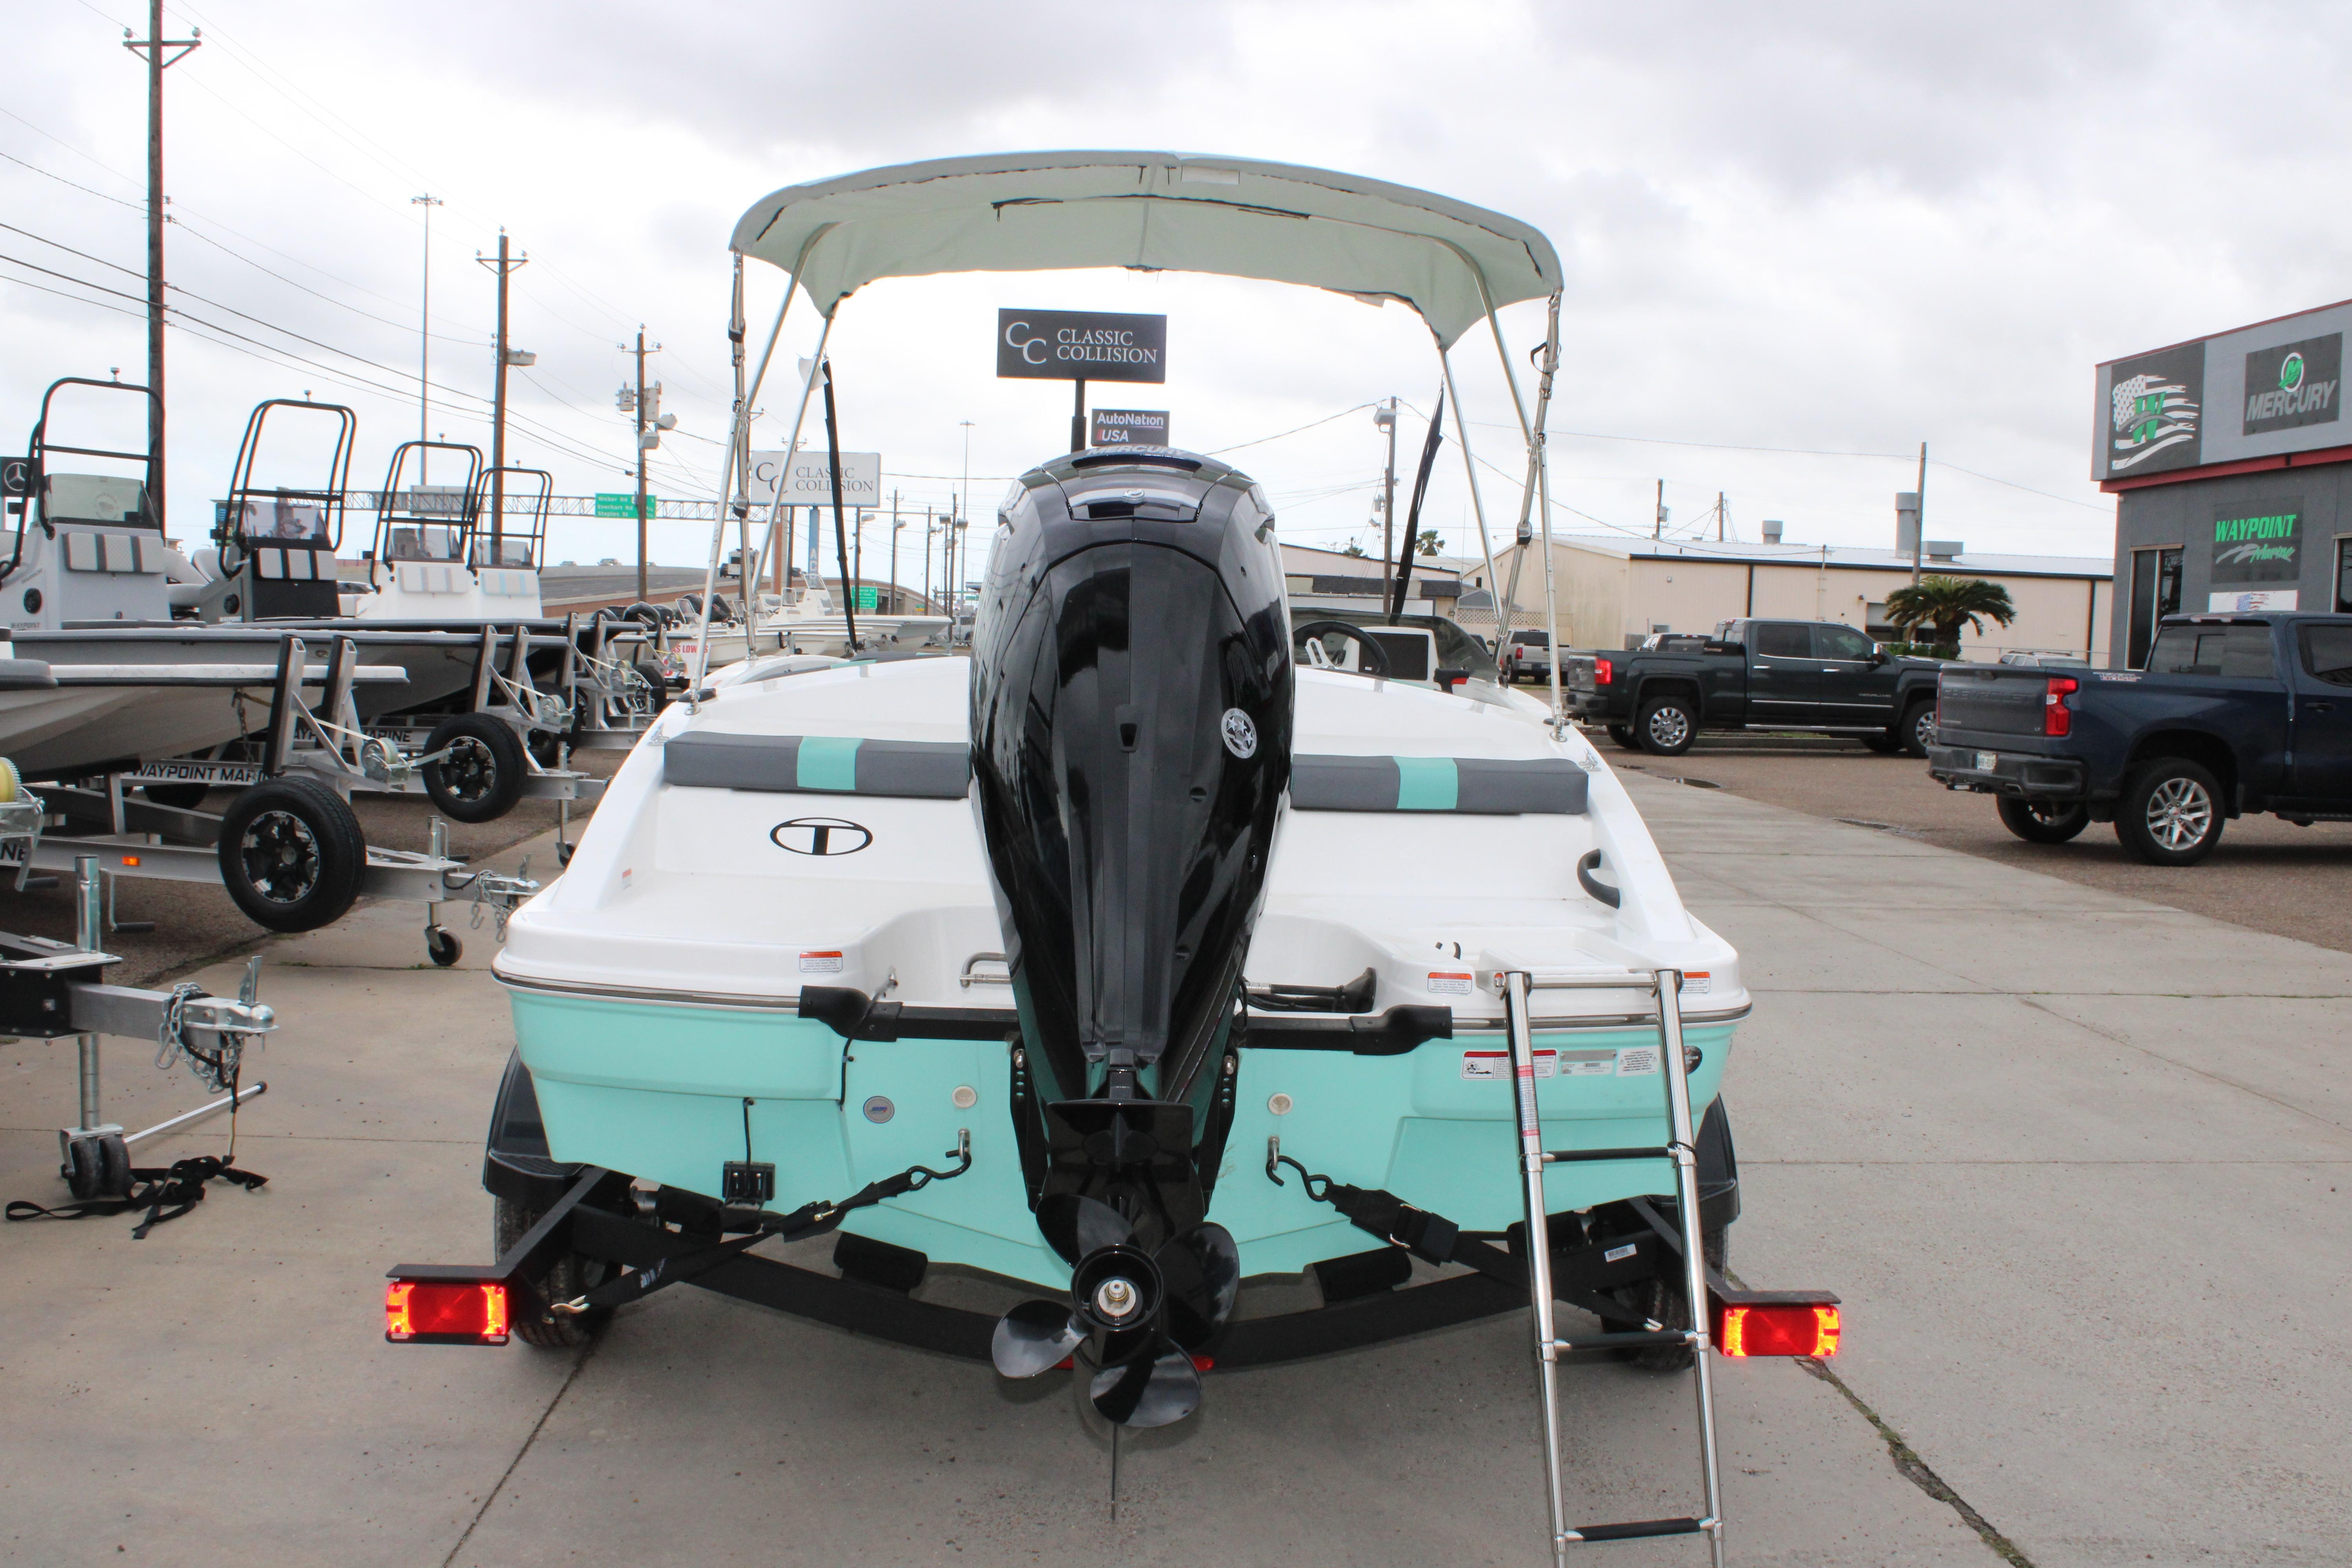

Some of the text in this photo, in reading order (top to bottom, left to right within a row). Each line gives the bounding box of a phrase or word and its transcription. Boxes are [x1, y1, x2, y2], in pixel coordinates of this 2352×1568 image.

[1057, 328, 1133, 346] CLASSIC
[1057, 346, 1157, 364] COLLISION
[2246, 379, 2337, 422] MERCURY
[1097, 412, 1164, 426] AutoNation
[1102, 430, 1129, 442] USA
[1085, 445, 1187, 457] MERCURY
[796, 467, 855, 478] CLASIC
[796, 480, 874, 492] COLLSION
[2215, 514, 2297, 542] WAYPOINT
[1944, 689, 2037, 704] CHEVROLET
